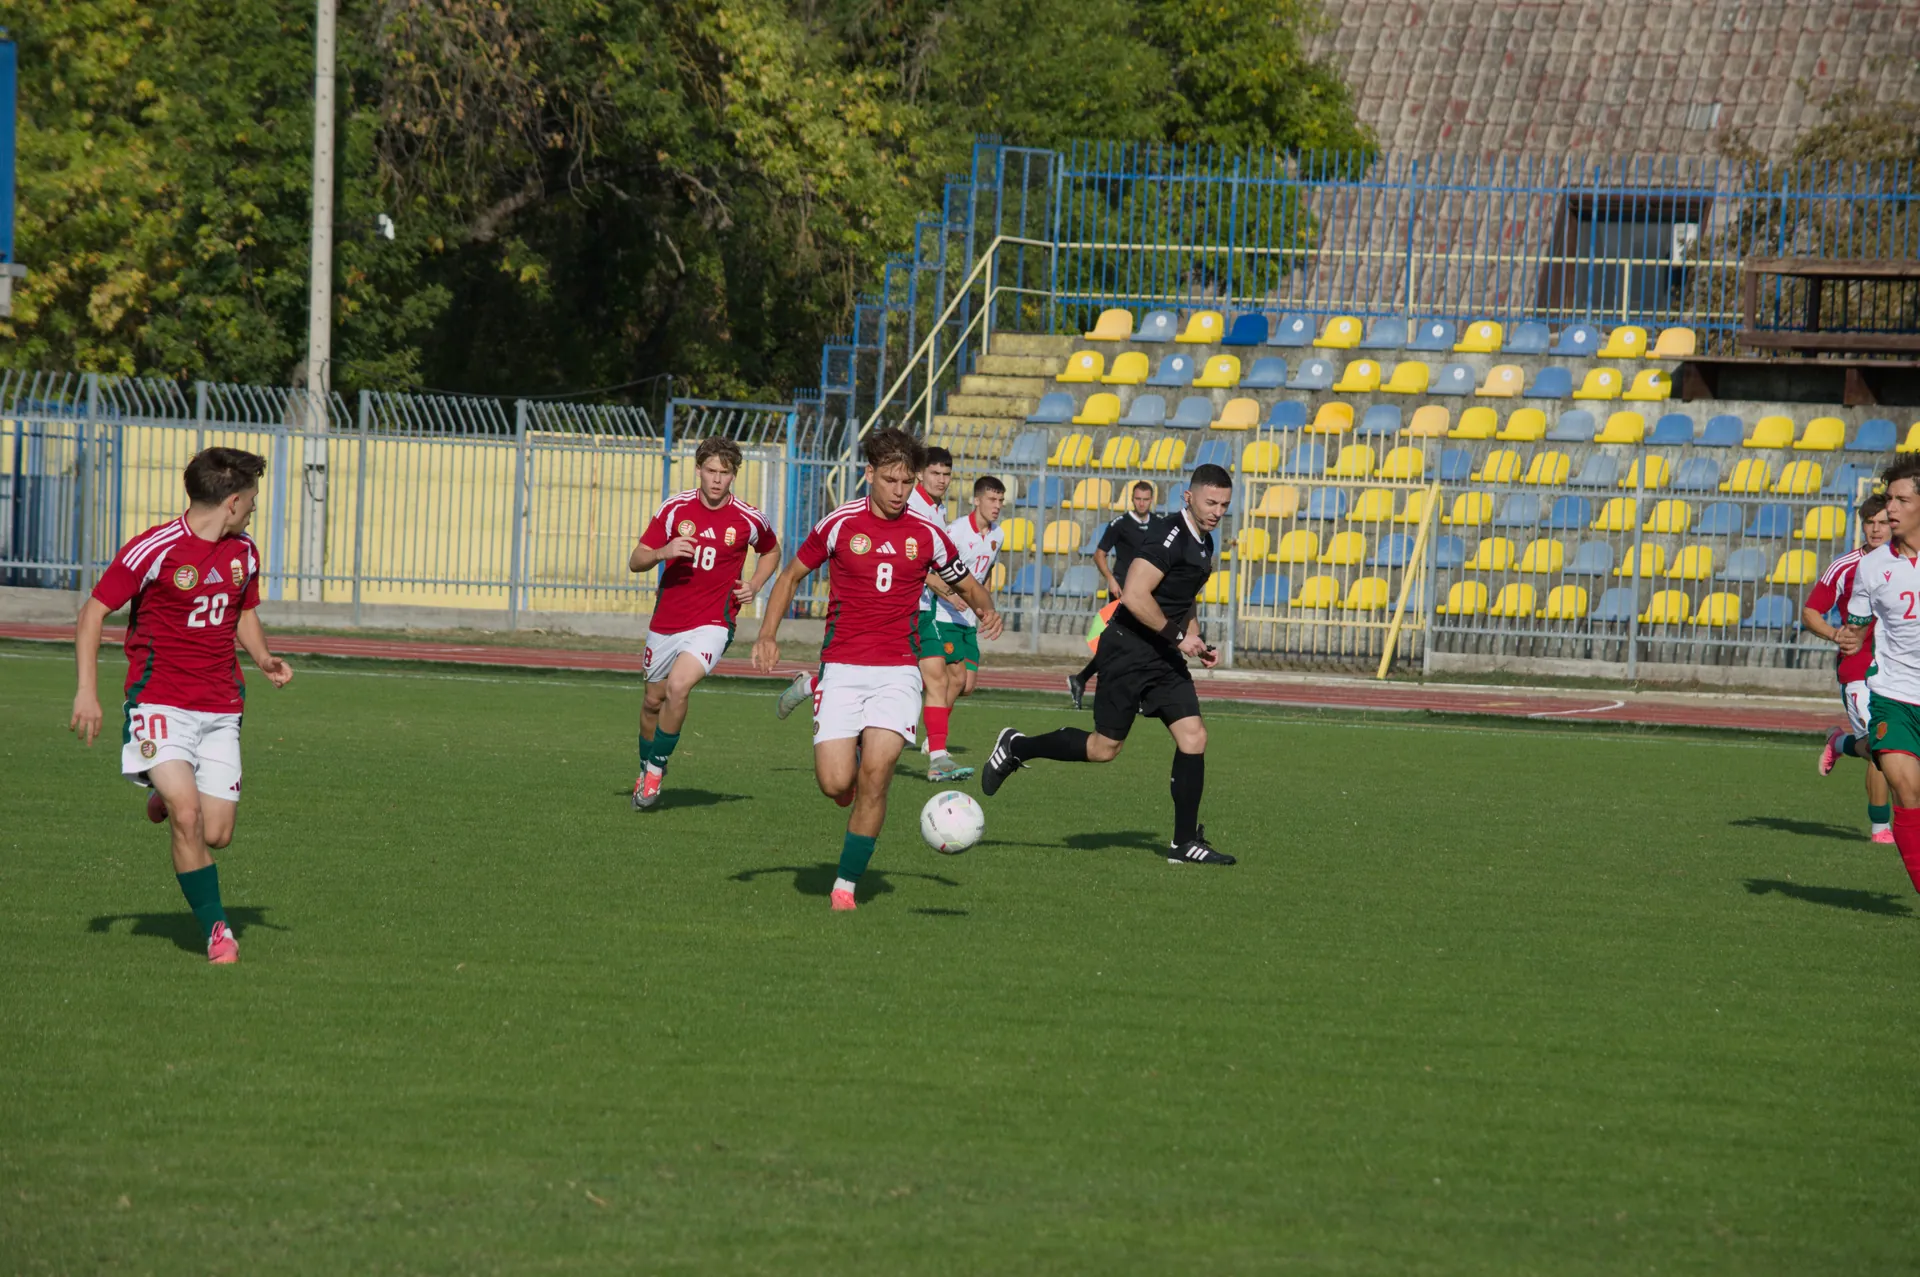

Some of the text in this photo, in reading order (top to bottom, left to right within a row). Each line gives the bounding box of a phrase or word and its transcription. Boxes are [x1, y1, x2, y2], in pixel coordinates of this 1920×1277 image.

[692, 545, 717, 571] 18
[953, 559, 967, 575] C
[974, 555, 990, 574] 17
[875, 562, 894, 593] 8
[187, 593, 229, 628] 20
[1899, 591, 1920, 620] 2
